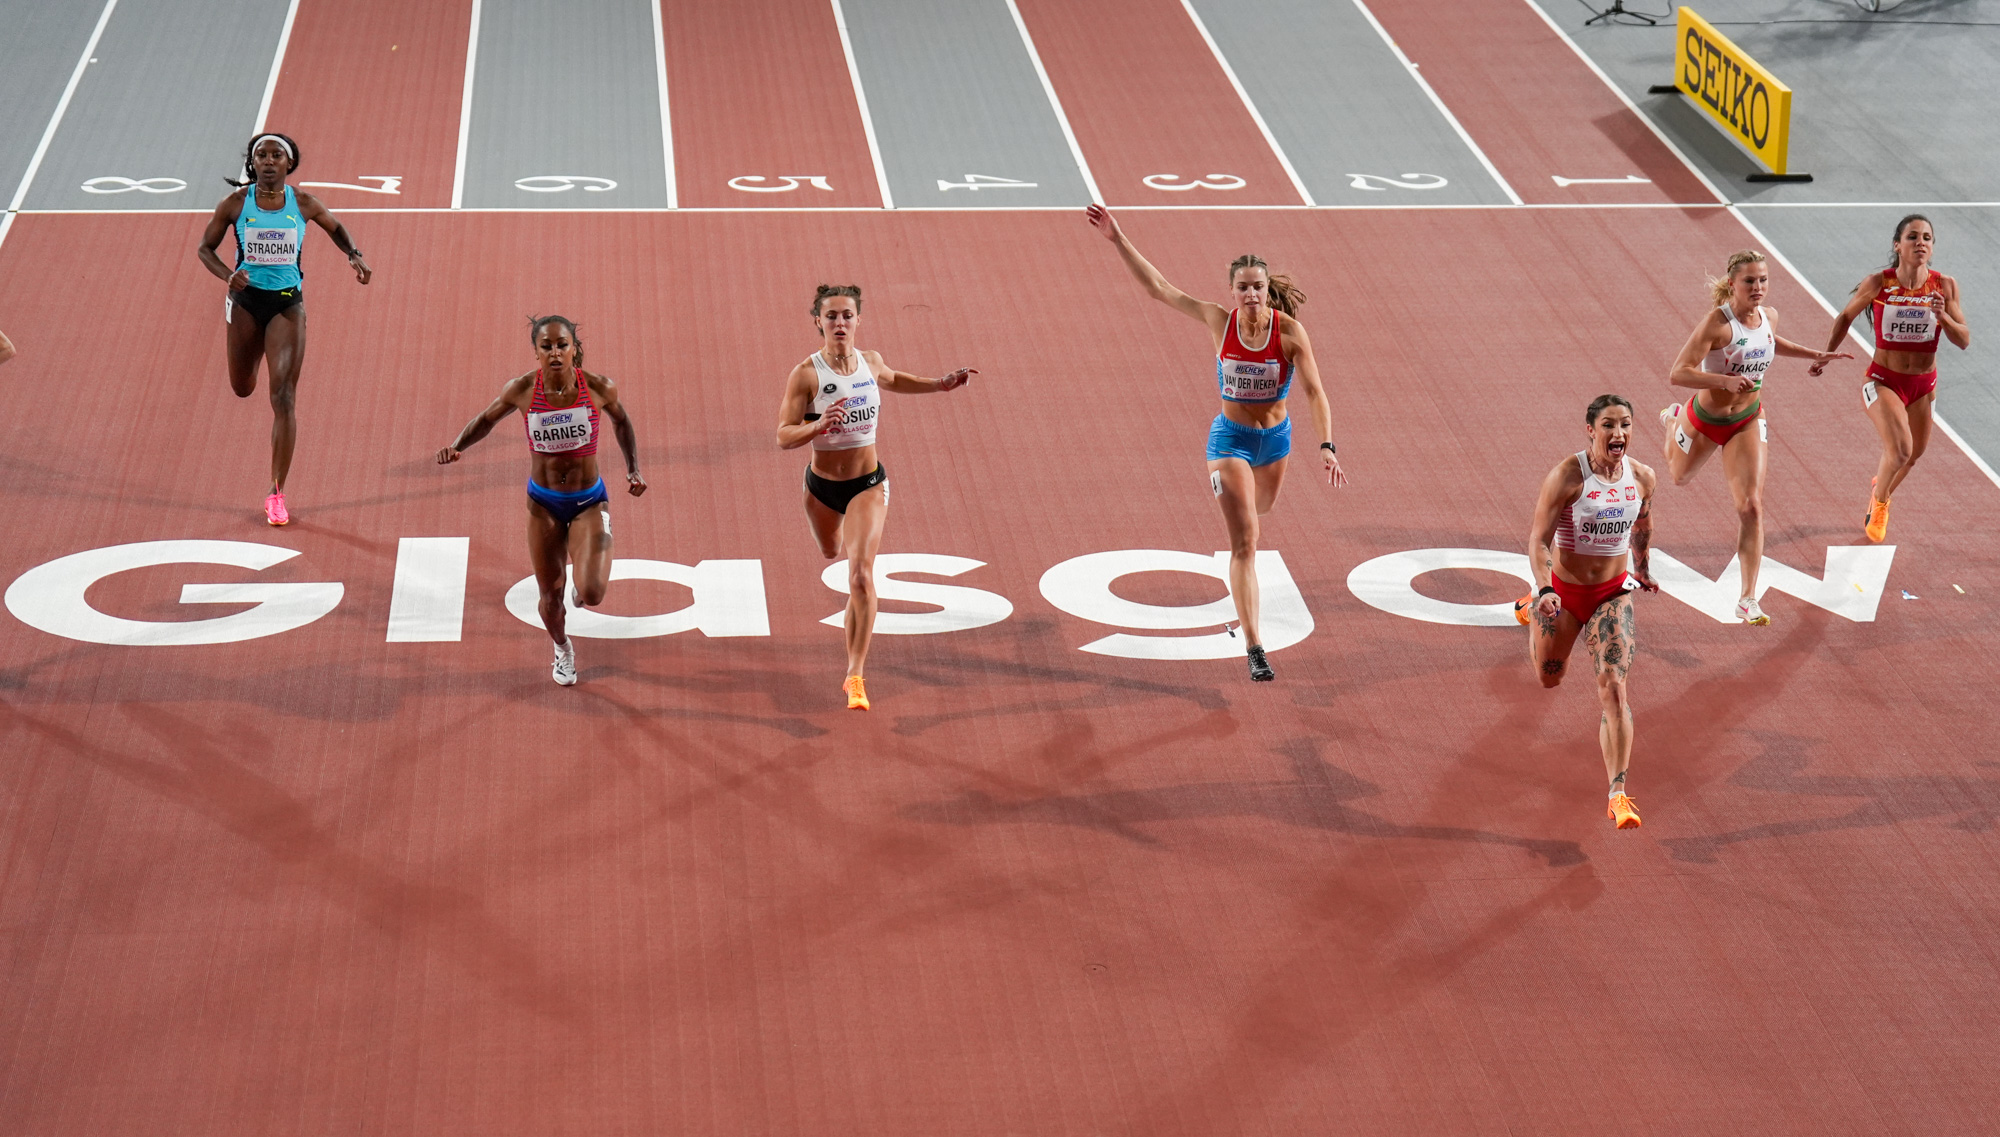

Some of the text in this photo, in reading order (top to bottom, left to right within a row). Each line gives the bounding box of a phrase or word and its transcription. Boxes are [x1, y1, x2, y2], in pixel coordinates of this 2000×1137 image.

[1684, 27, 1770, 149] SEIKO
[81, 176, 188, 195] 8
[299, 175, 403, 195] 7
[515, 175, 618, 193] 6
[728, 175, 834, 193] 5
[936, 173, 1039, 192] 4
[1142, 173, 1247, 191] 3
[1345, 172, 1449, 192] 2
[1551, 175, 1652, 187] 1
[247, 242, 295, 255] STRACHAN
[1891, 321, 1930, 334] PÉREZ
[1731, 360, 1770, 373] TAKÁCS
[1224, 374, 1277, 390] VAN DER WEKEN
[533, 424, 587, 442] BARNES
[1677, 432, 1686, 448] 2
[547, 442, 580, 451] GLASGOW
[1586, 490, 1602, 500] 4F
[4, 537, 1897, 661] Glasgow
